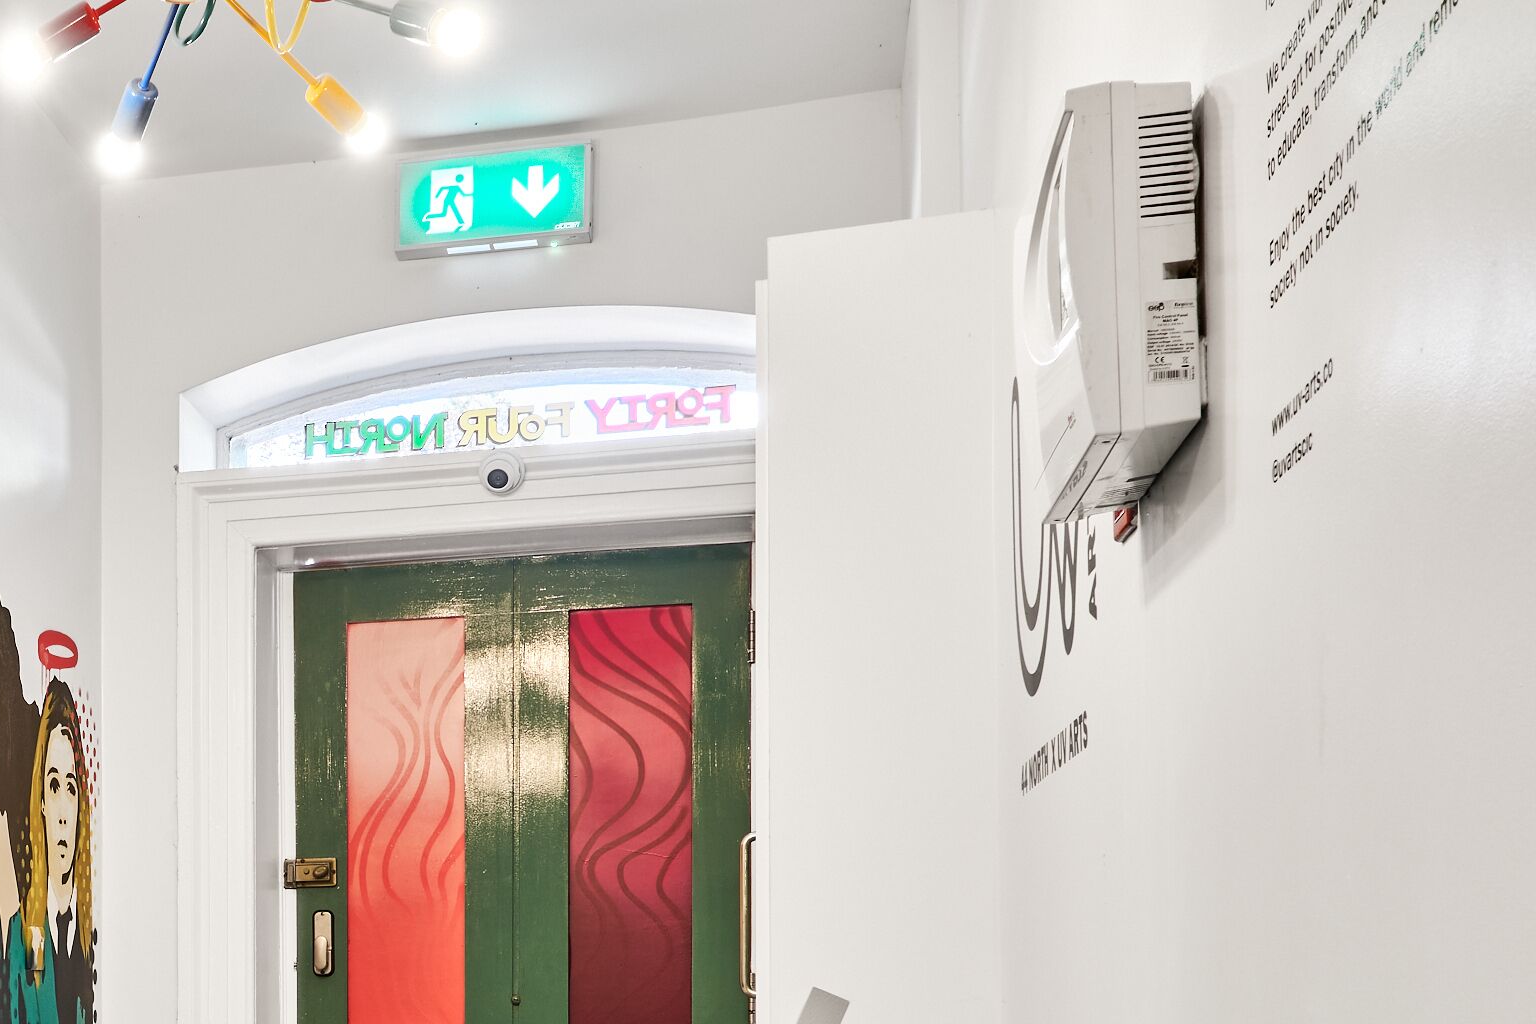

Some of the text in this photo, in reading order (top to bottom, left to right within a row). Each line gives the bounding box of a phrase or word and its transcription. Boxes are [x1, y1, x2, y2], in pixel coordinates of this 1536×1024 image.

[1266, 62, 1279, 94] We
[1280, 17, 1306, 71] create
[1267, 0, 1379, 181] to educate, transform and
[1267, 85, 1290, 138] street
[1291, 63, 1303, 100] art
[1304, 44, 1317, 79] for
[1269, 221, 1291, 266] Enjoy
[1291, 203, 1306, 236] the
[1307, 170, 1326, 216] best
[1328, 148, 1344, 189] city
[1346, 135, 1355, 163] in
[1356, 110, 1373, 146] the
[1375, 57, 1403, 119] world
[1406, 21, 1426, 77] and
[1269, 180, 1360, 310] society not in society.
[1272, 358, 1333, 437] www.uv-arts.co
[1029, 741, 1049, 791] NORTH
[1051, 736, 1057, 774] X
[1057, 727, 1067, 768] UV
[1069, 710, 1088, 761] ARTS
